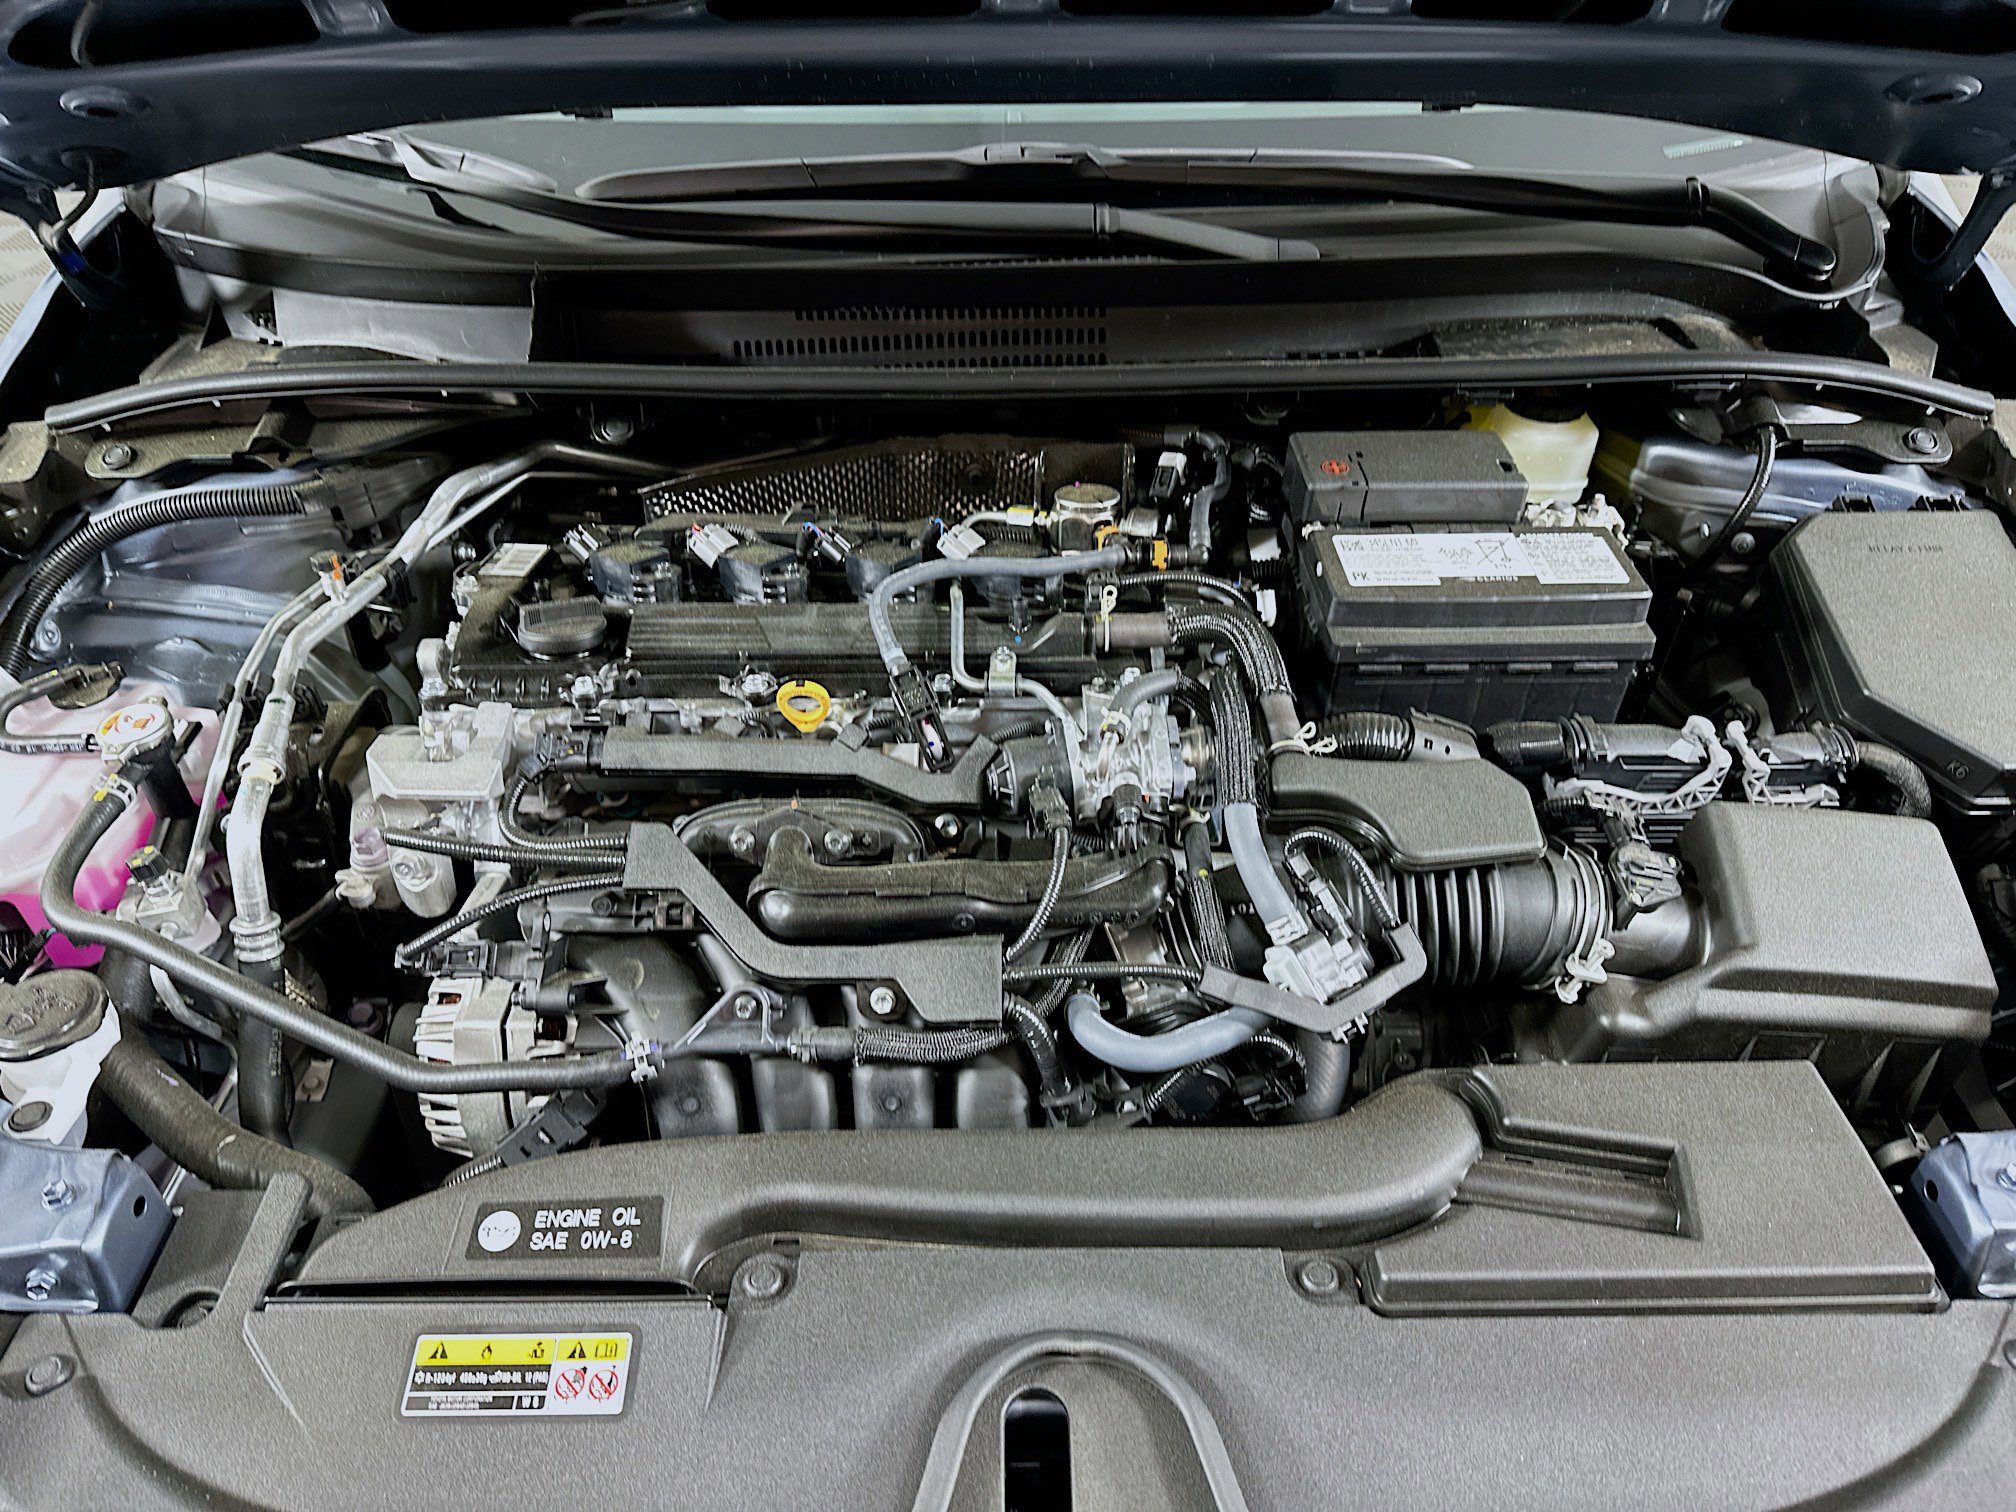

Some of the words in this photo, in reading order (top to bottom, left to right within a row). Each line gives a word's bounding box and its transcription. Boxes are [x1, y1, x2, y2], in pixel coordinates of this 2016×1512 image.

[534, 1208, 602, 1228] ENGINE
[612, 1206, 641, 1226] OIL
[530, 1231, 569, 1250] SAE
[580, 1229, 633, 1249] 0W-8
